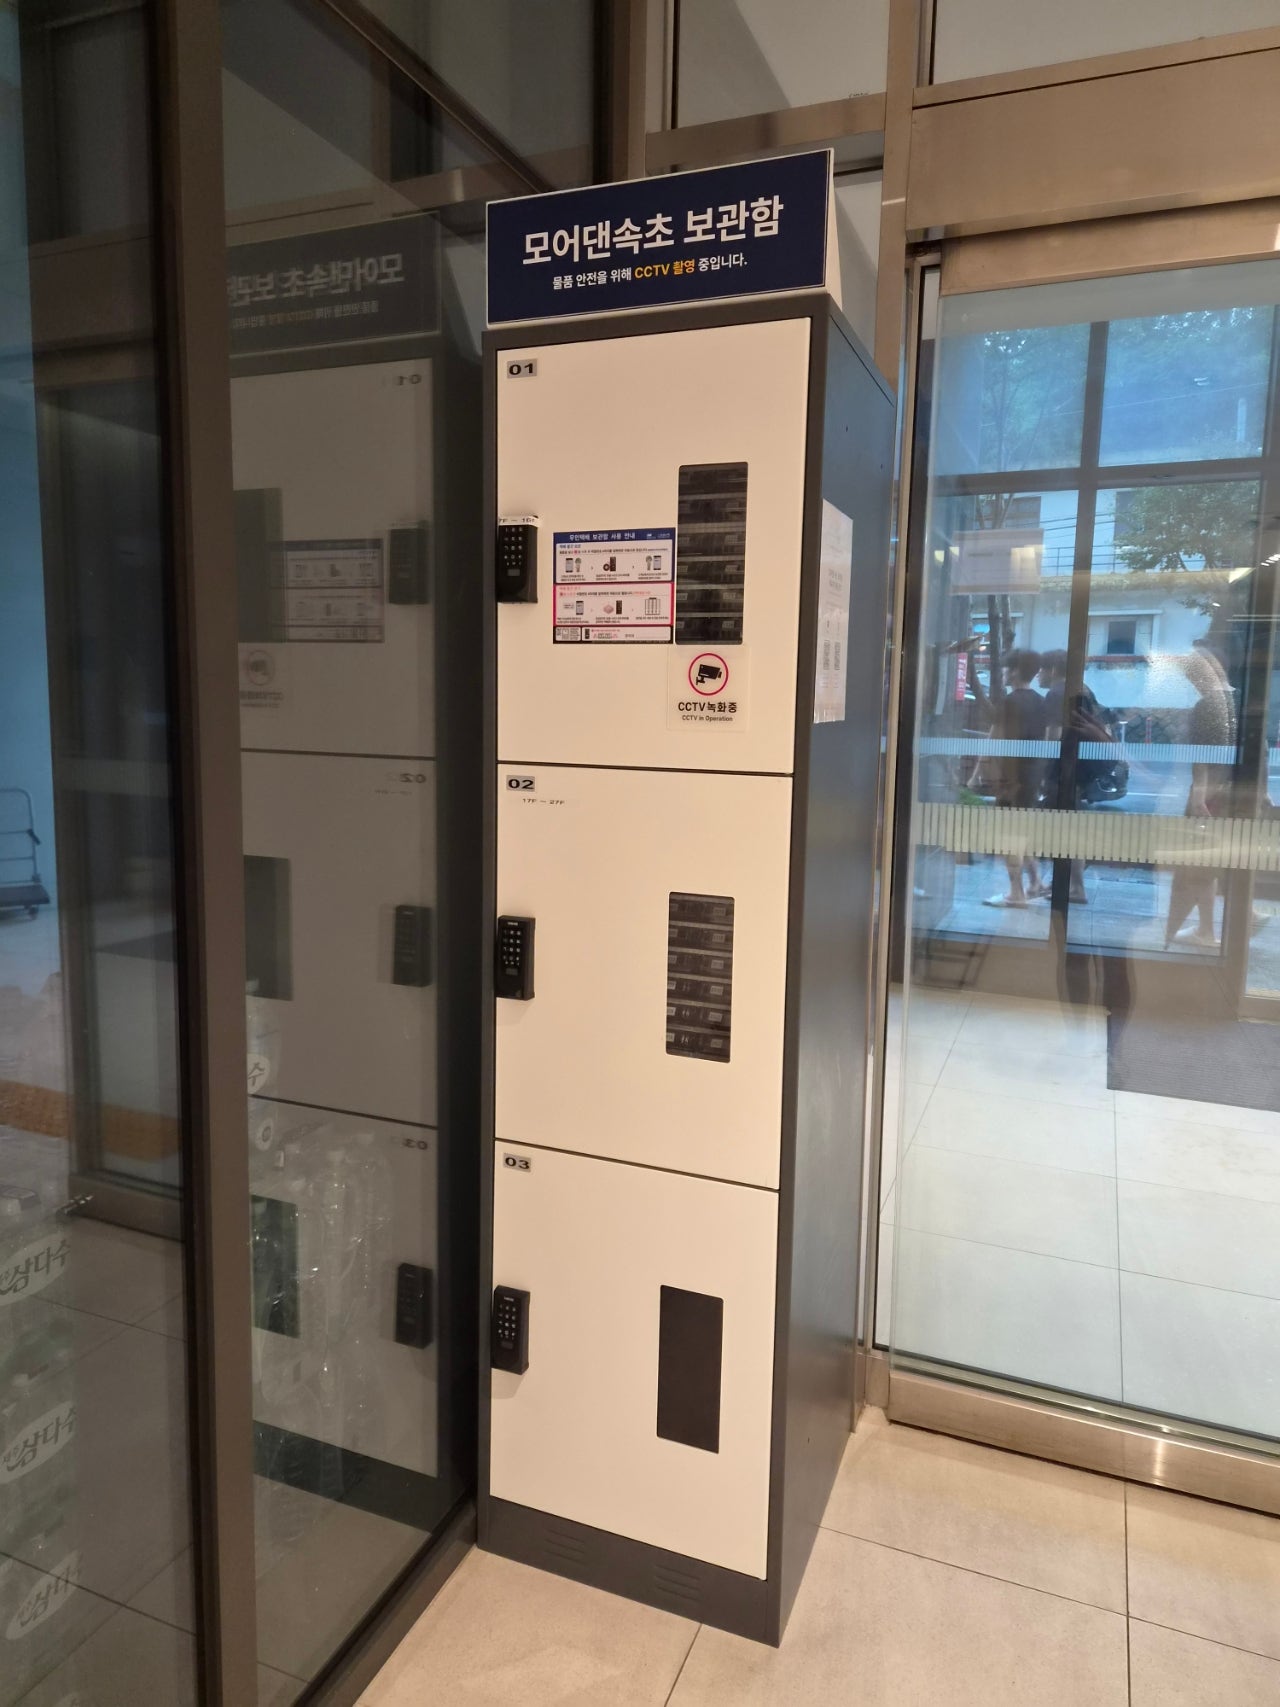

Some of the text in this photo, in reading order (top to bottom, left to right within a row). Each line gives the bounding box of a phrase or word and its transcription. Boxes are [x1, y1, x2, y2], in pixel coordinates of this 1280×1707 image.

[522, 195, 785, 265] 모어댄속초 보관함
[552, 252, 748, 291] 물품 안전을 위해 CCTV 촬영 중입니다.
[508, 362, 535, 376] 01
[508, 778, 535, 790] 02
[505, 1156, 530, 1170] 03
